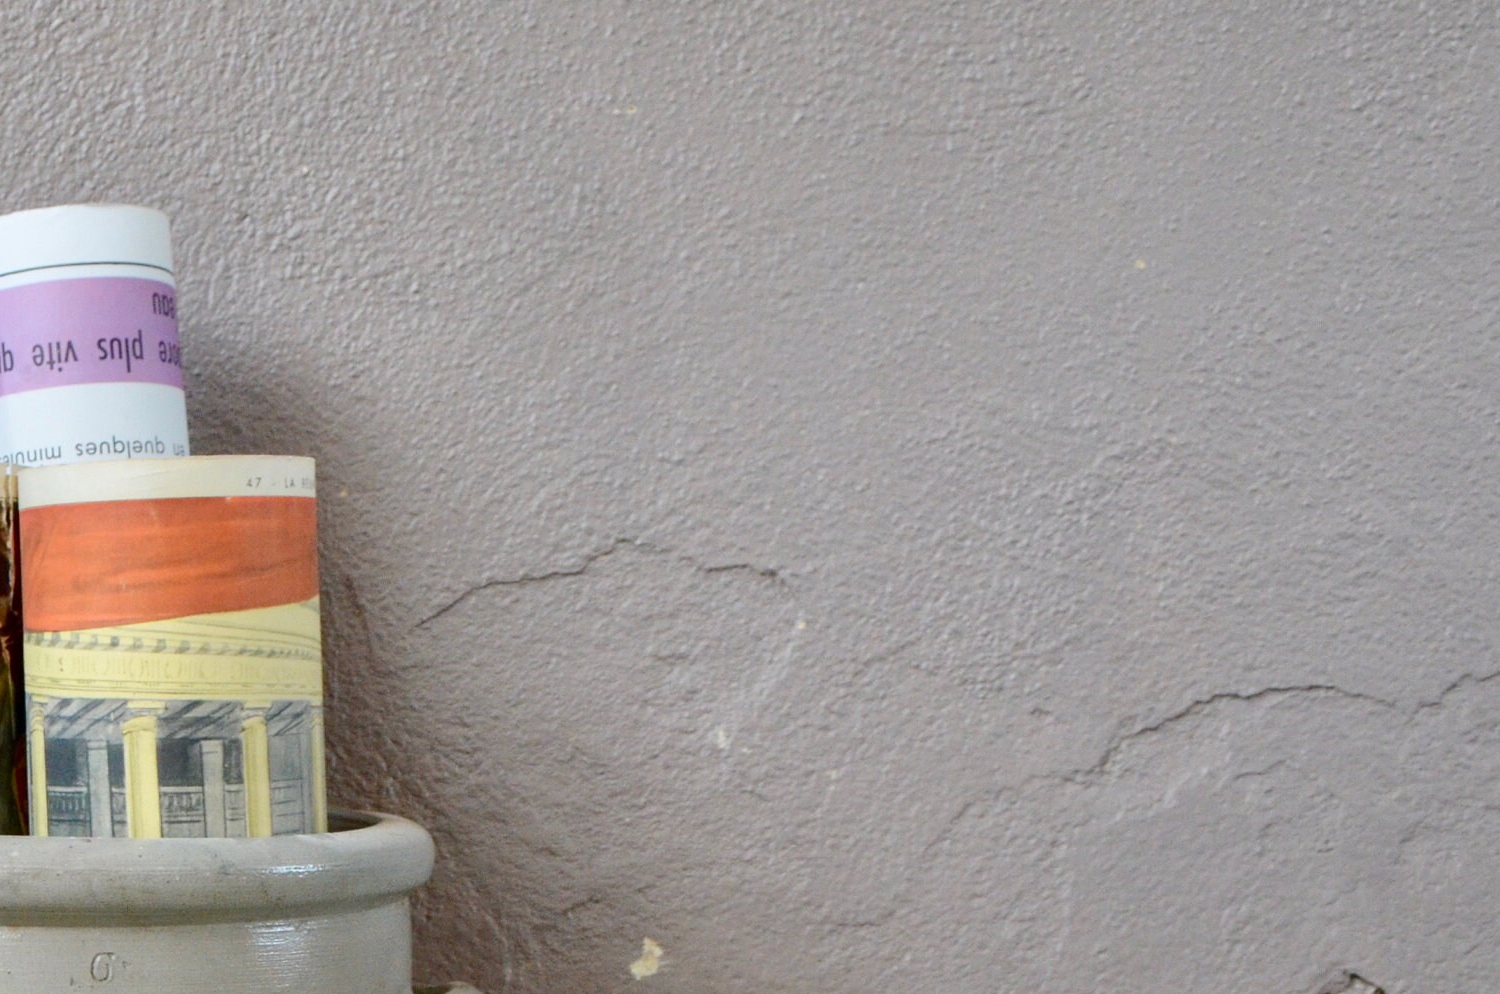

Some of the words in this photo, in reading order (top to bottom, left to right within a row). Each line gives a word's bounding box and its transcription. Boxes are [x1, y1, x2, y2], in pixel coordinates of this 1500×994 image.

[31, 340, 79, 373] vite
[96, 329, 144, 374] plus
[74, 436, 166, 460] quelques
